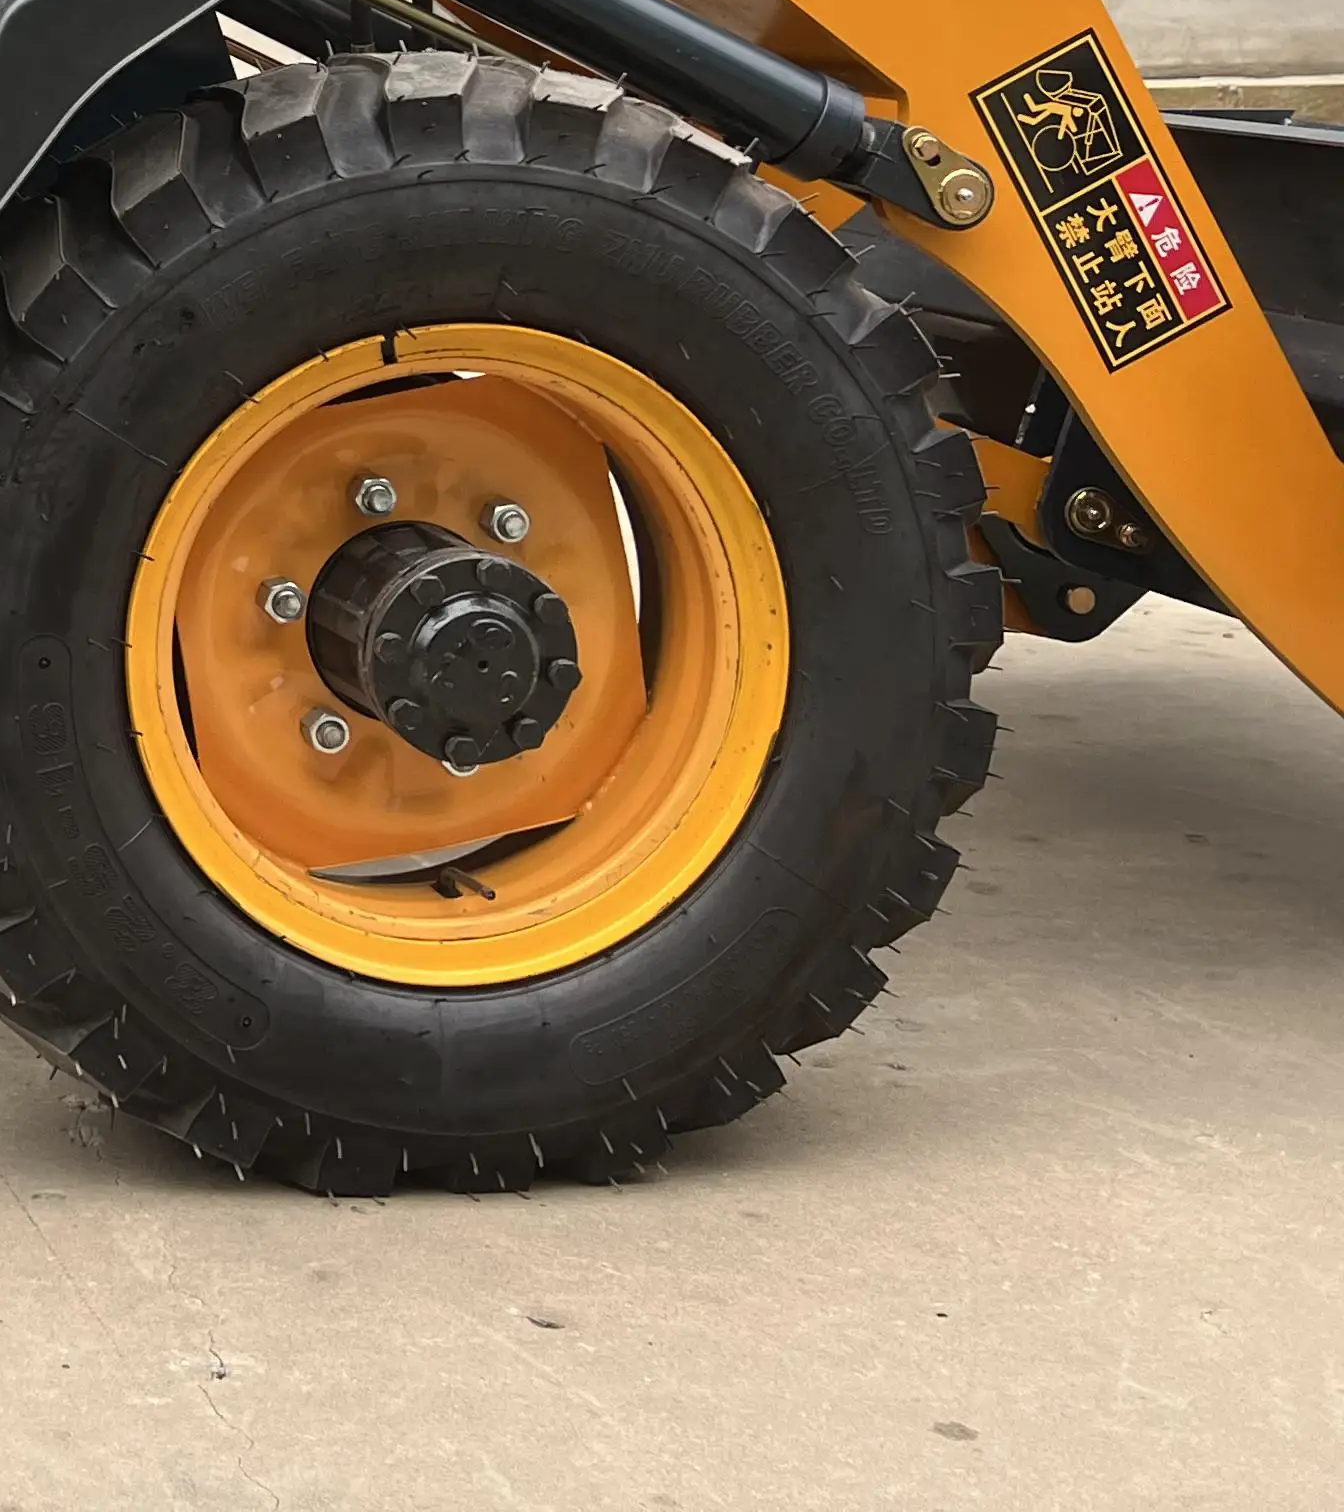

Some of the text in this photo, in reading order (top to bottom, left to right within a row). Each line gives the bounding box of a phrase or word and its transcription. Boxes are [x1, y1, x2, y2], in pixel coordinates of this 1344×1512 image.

[1055, 212, 1137, 348] 禁止站人
[1086, 197, 1173, 331] 大臂下面
[1150, 226, 1202, 296] 危险
[678, 265, 819, 396] RUBBER
